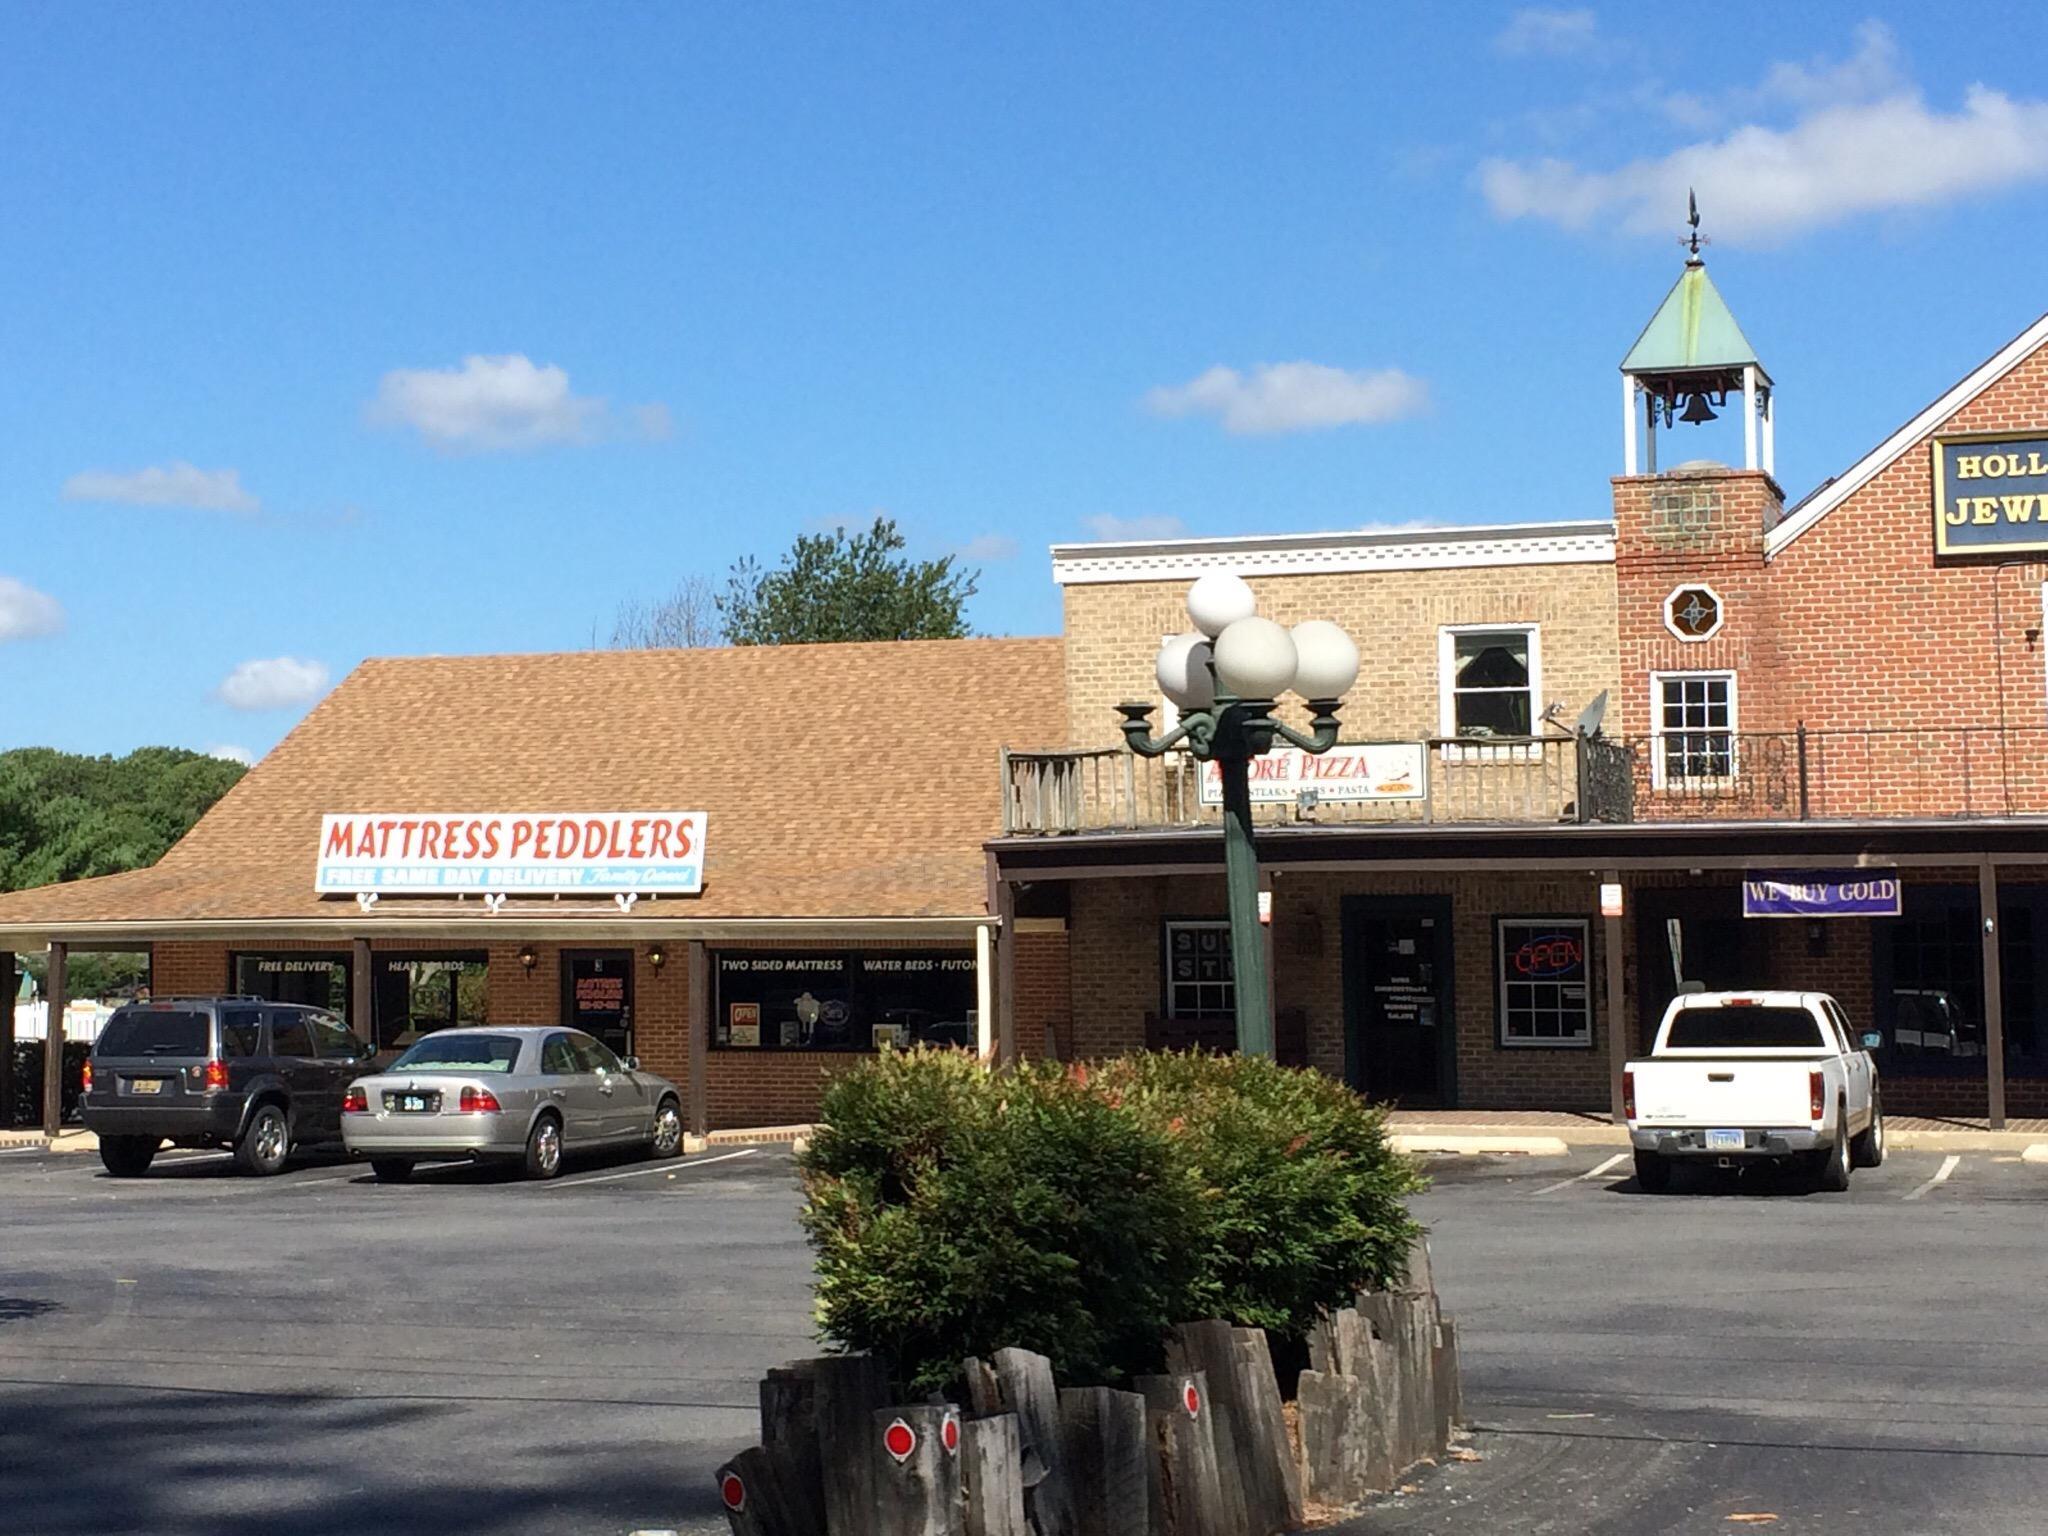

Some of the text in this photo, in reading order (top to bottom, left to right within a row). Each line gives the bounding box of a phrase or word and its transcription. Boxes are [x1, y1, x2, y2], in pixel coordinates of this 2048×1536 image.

[1299, 754, 1370, 781] PIZZA
[1338, 784, 1370, 795] PASTA
[325, 819, 694, 860] MATTRESS PEDDLERS
[326, 867, 377, 885] FREE
[380, 867, 440, 885] SAME
[444, 867, 483, 885] DAY
[488, 867, 584, 885] DELIVERY
[1838, 879, 1895, 900] GOLD
[1515, 940, 1583, 973] OPEN
[258, 961, 334, 972] FREE DELIVERY
[722, 960, 844, 971] TWO SIDED MATTRESS
[863, 960, 902, 971] WATER
[904, 960, 934, 971] BEDS
[733, 1007, 757, 1023] OPEN
